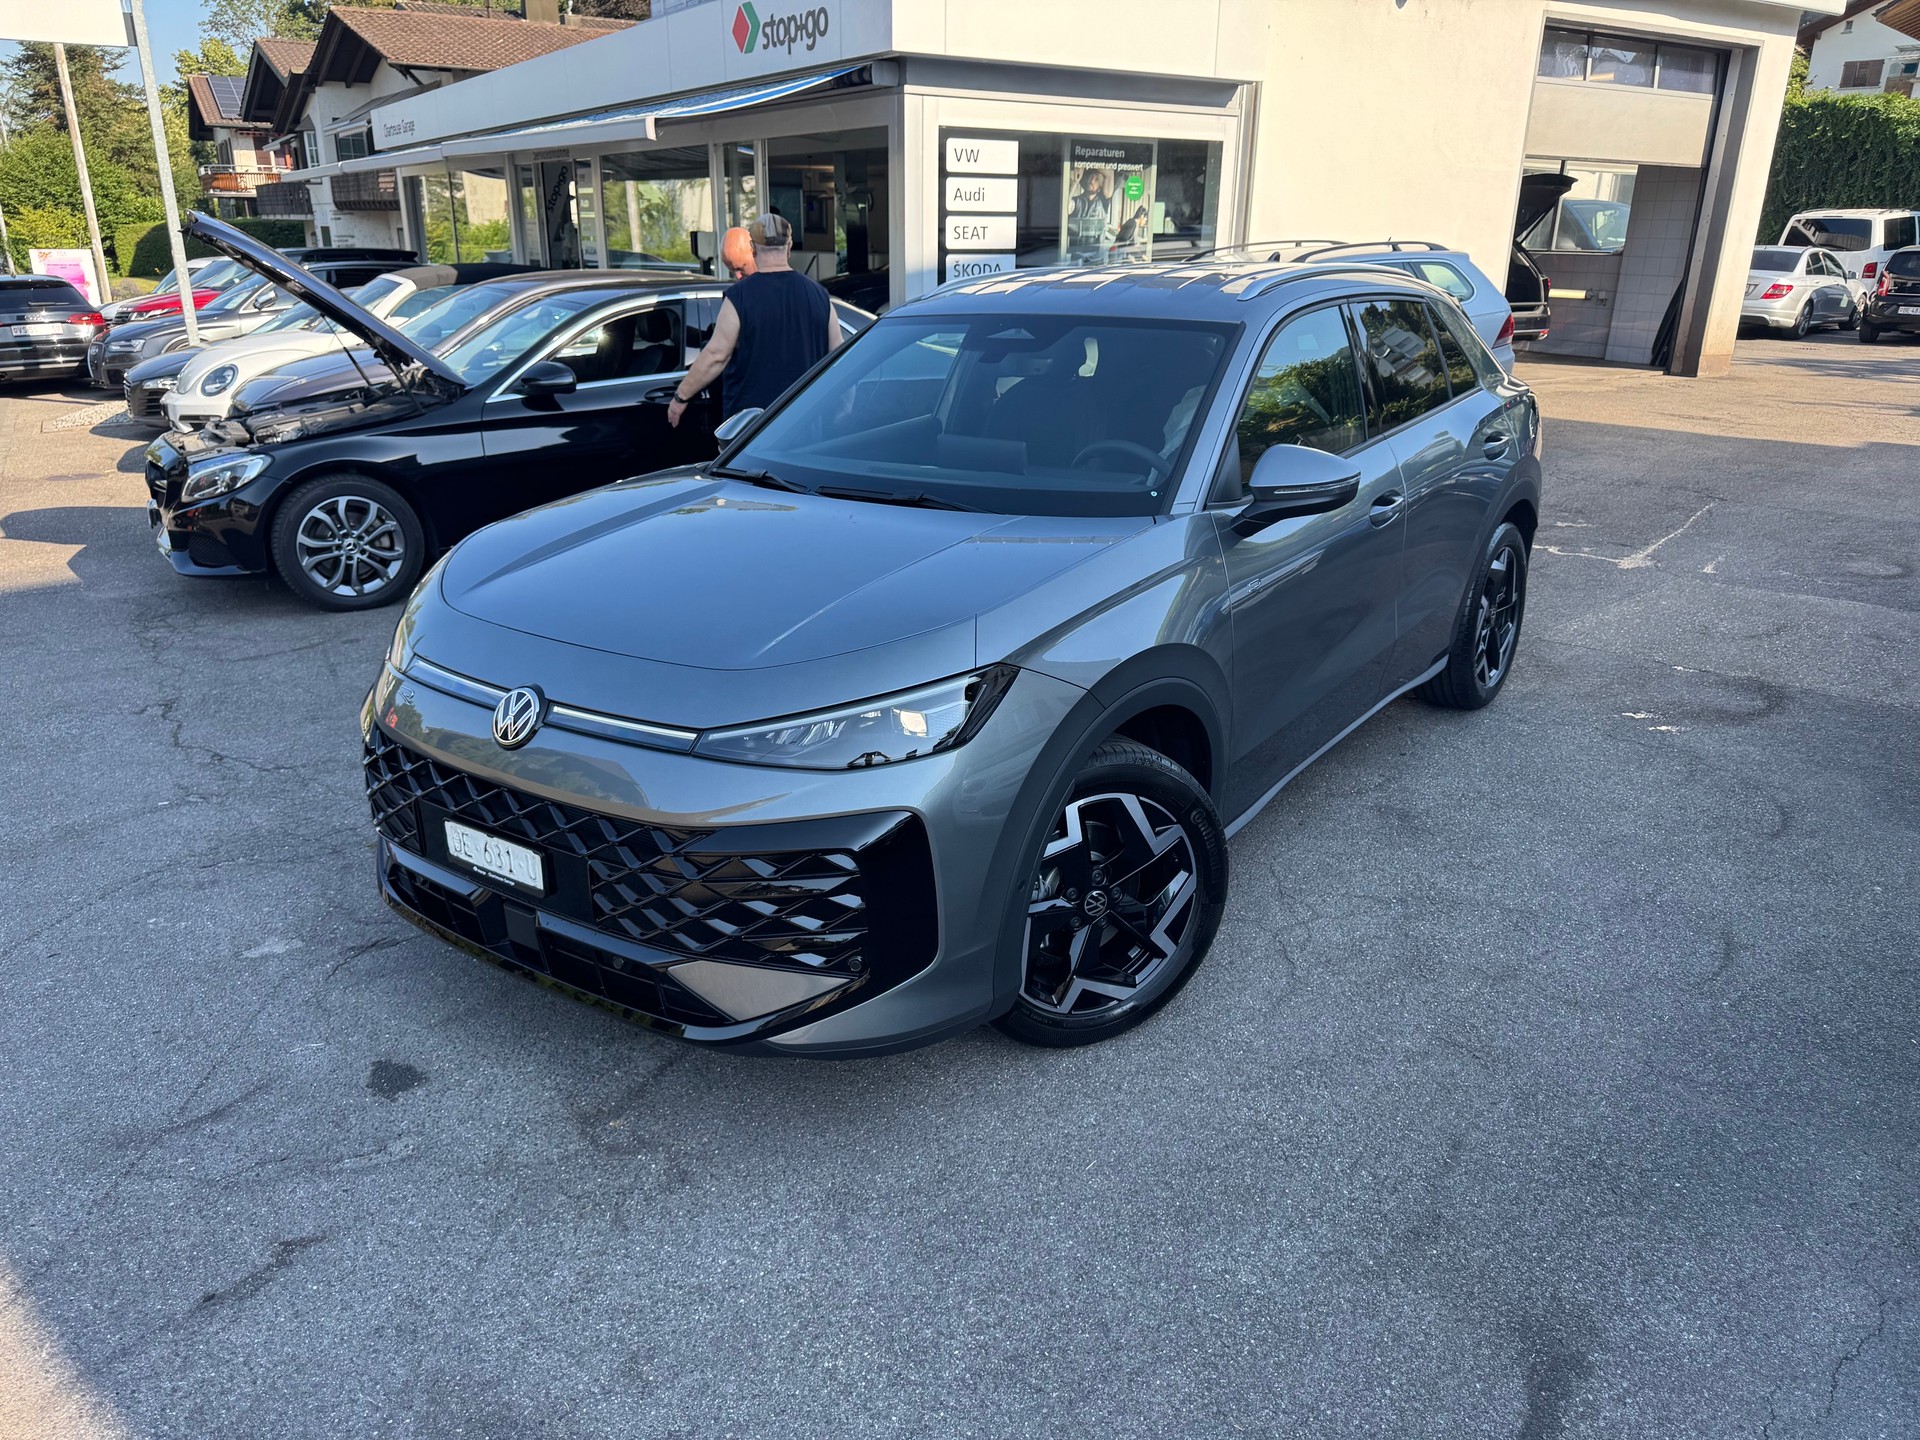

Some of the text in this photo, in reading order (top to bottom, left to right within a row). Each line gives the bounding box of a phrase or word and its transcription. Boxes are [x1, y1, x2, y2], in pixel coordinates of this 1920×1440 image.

[762, 7, 828, 55] stop+go
[954, 148, 980, 163] VW
[1075, 146, 1126, 159] Reparaturen
[1074, 160, 1144, 172] kompetent und preiswert
[953, 187, 985, 202] Audi
[953, 226, 989, 240] SEAT
[953, 260, 1002, 278] ŠKODA
